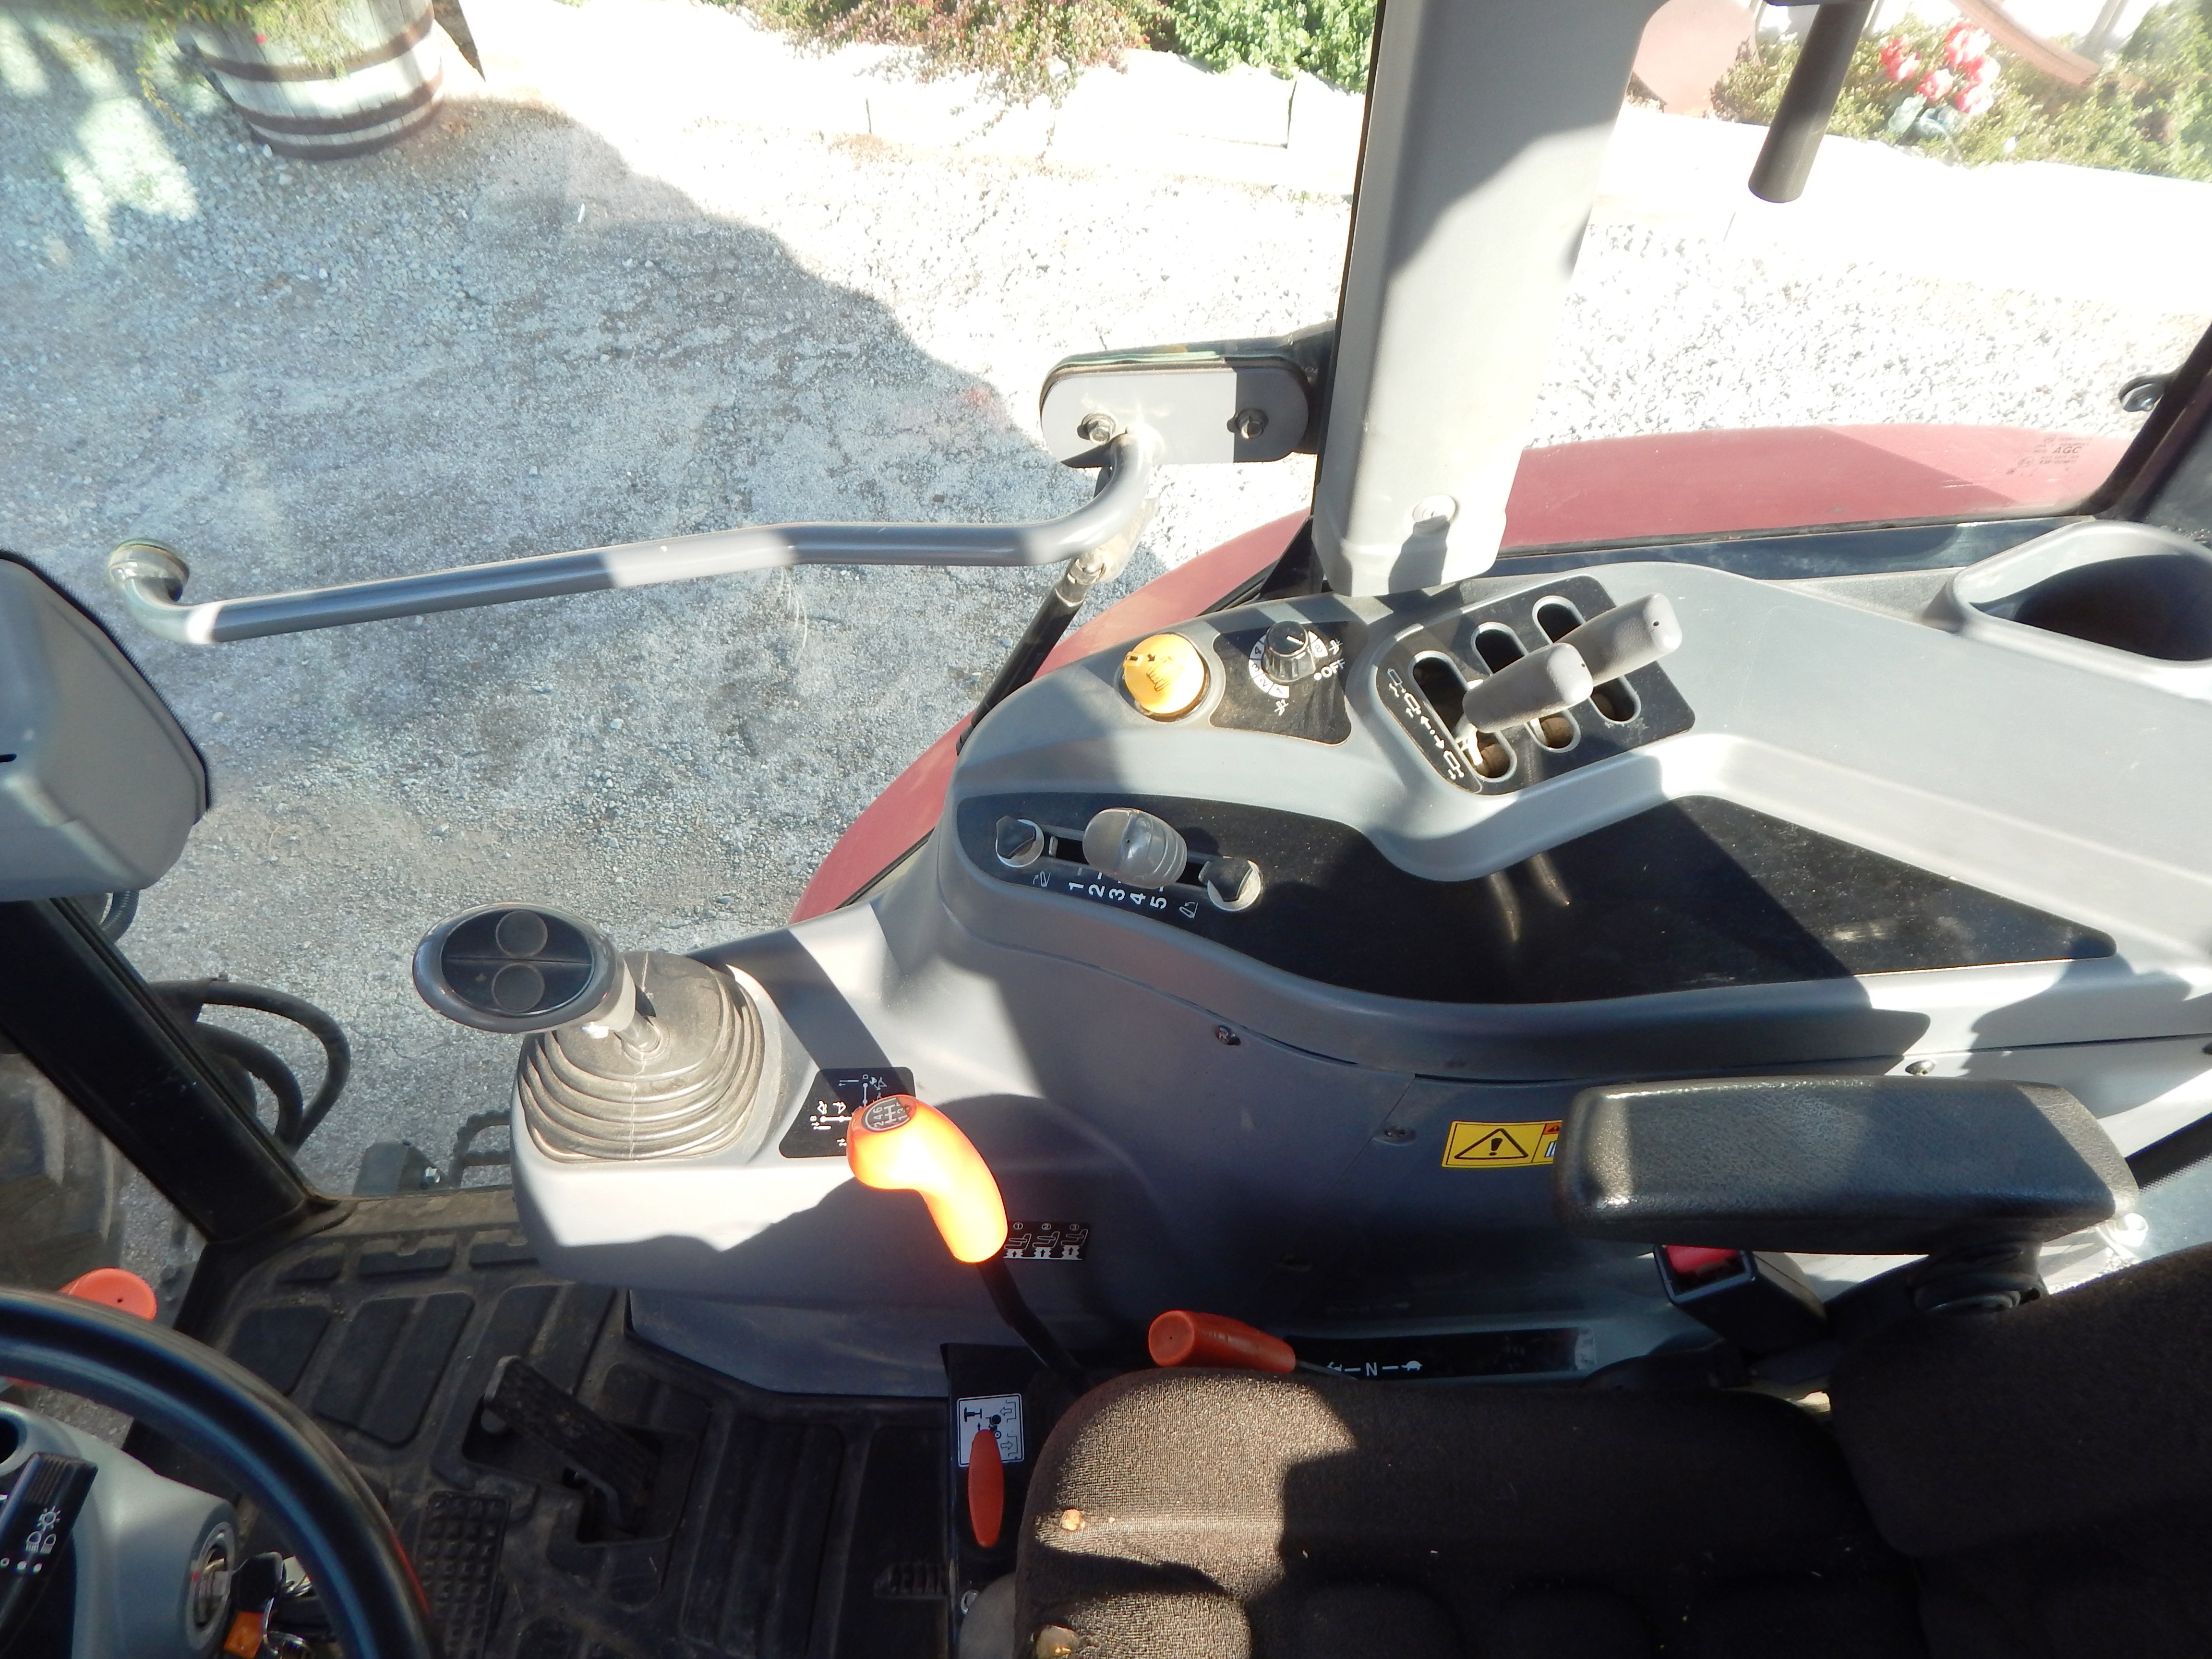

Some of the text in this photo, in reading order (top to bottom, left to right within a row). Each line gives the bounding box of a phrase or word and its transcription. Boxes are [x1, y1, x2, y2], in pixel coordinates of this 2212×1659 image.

[2052, 446, 2082, 454] AGC
[1254, 646, 1262, 654] 4
[1252, 663, 1260, 673] 3
[1321, 658, 1346, 678] OFF
[1260, 678, 1268, 687] 2
[1068, 881, 1168, 910] 1 2 3 4 5
[1365, 1361, 1378, 1377] N
